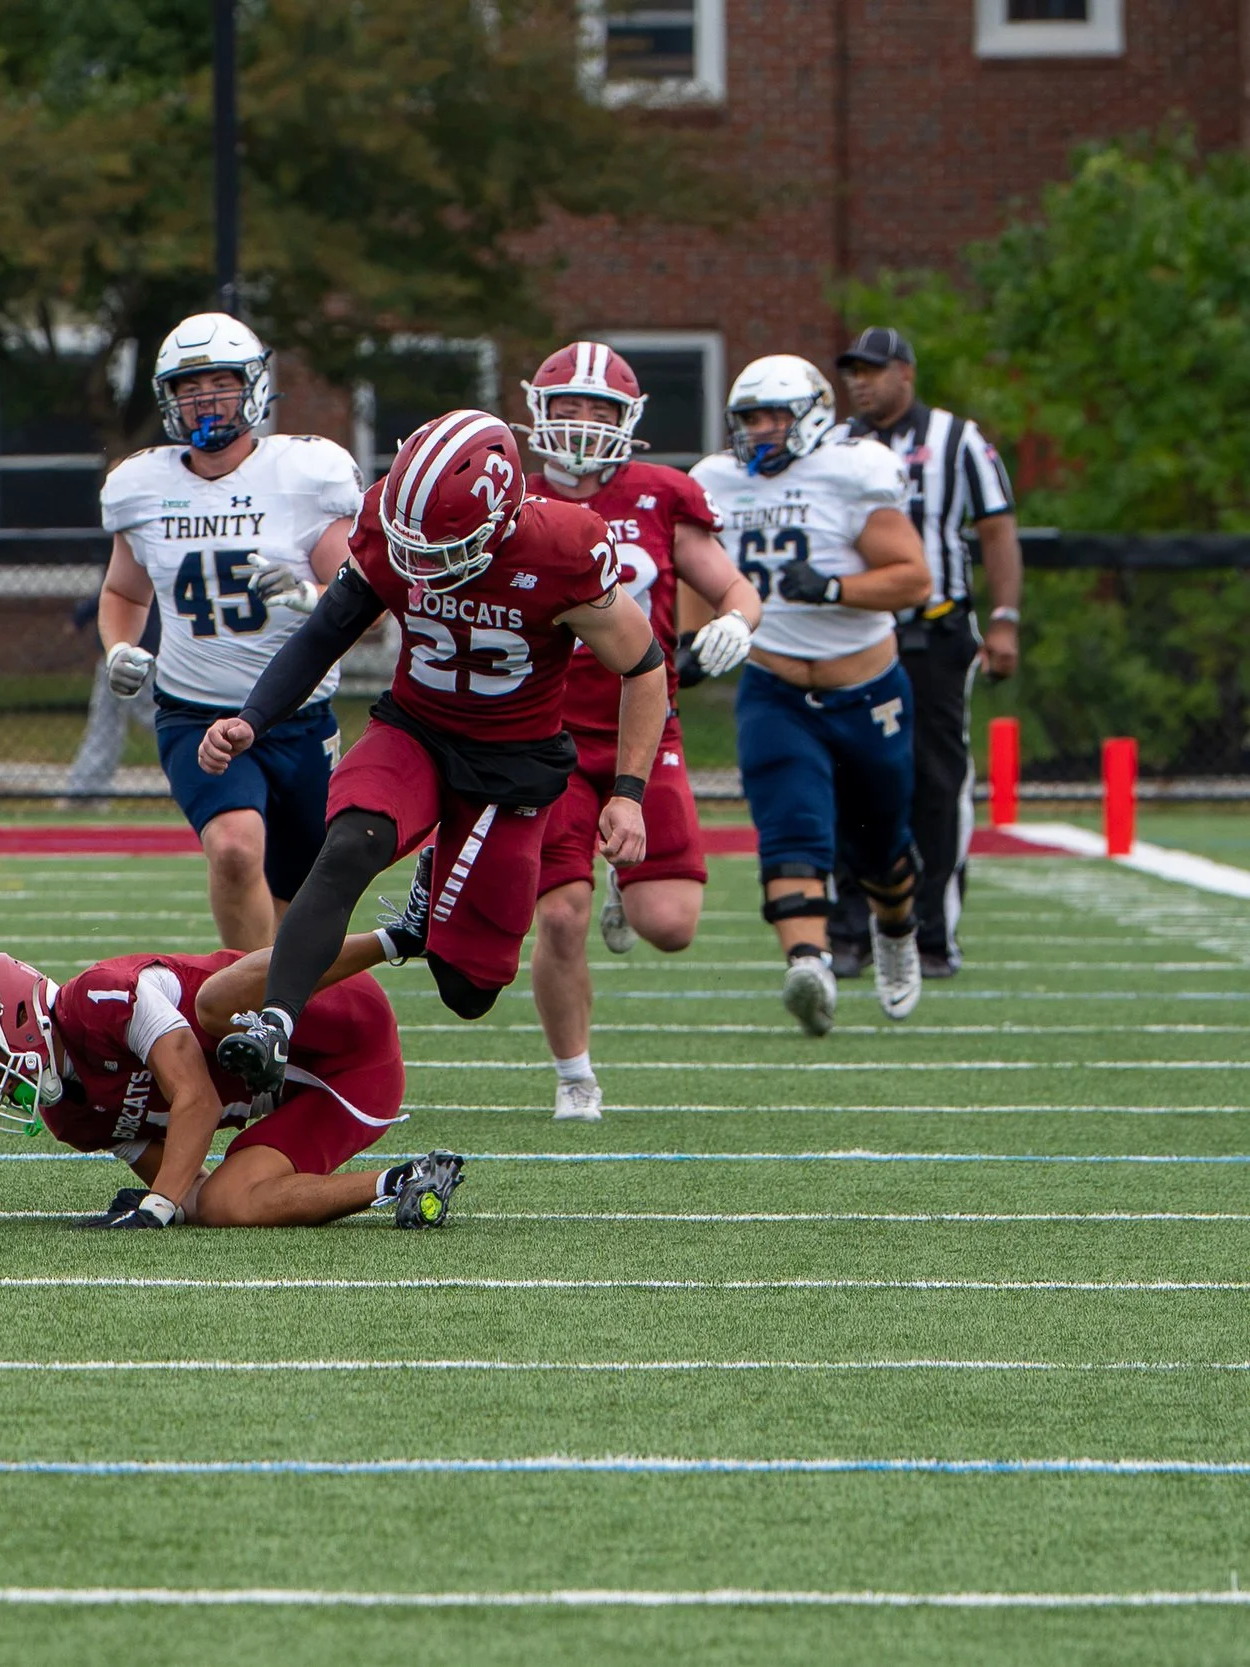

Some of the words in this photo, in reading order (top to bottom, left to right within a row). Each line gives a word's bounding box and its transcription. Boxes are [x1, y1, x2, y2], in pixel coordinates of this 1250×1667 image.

[470, 453, 514, 513] 23
[160, 512, 266, 539] TRINITY
[174, 549, 270, 639] 45
[403, 611, 534, 696] 23
[870, 696, 903, 738] T
[86, 989, 130, 1004] 1
[111, 1069, 153, 1140] BOBCATS
